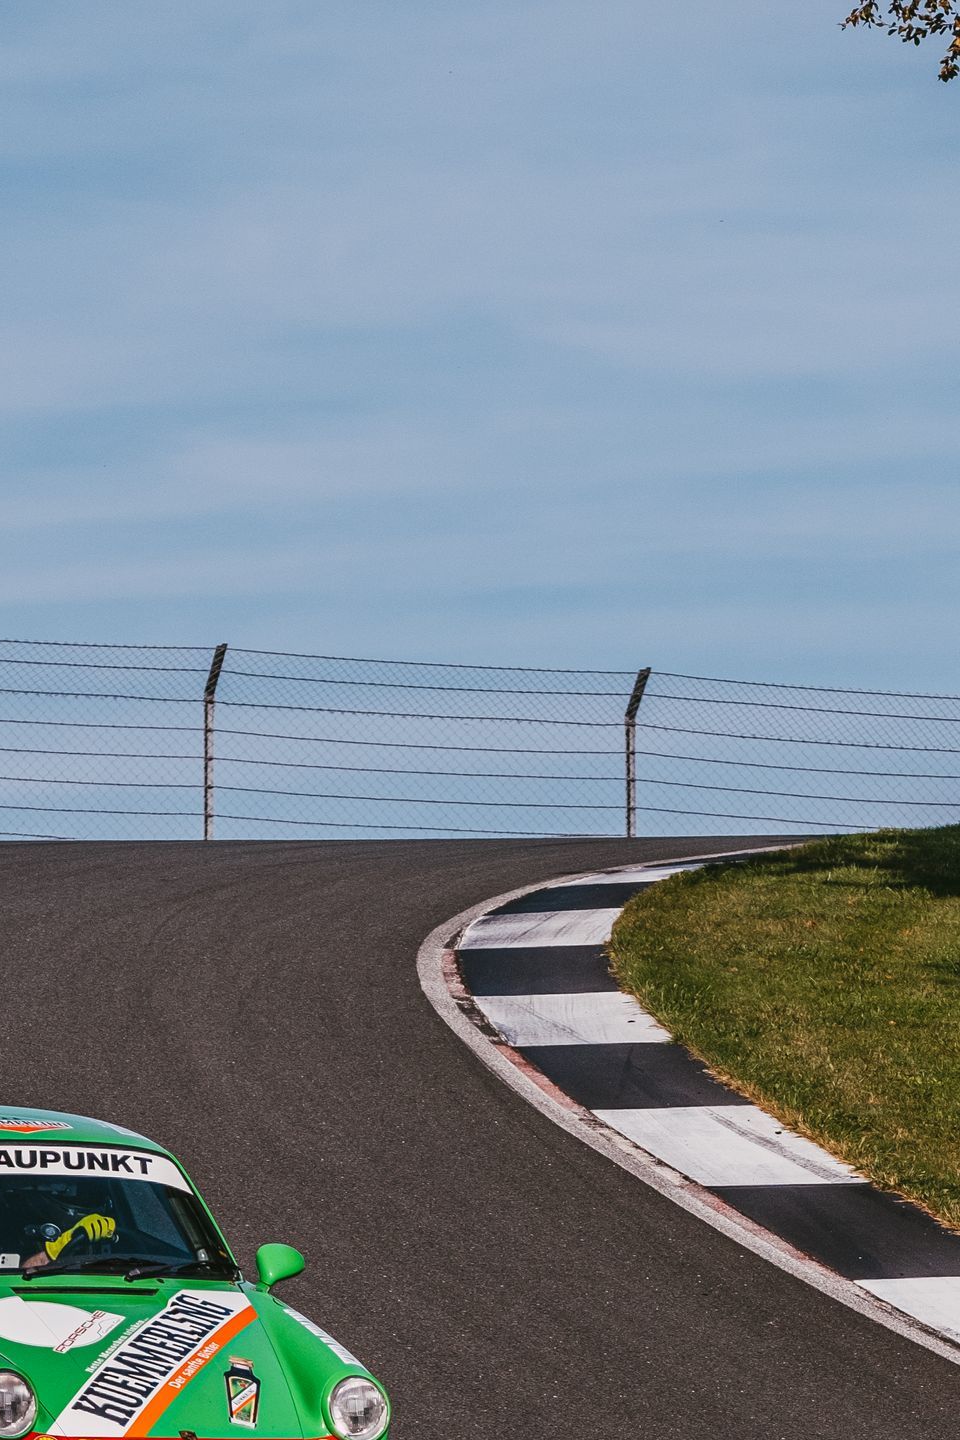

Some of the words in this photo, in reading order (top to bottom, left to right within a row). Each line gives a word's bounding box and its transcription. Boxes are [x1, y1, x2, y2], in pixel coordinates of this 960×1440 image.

[56, 1309, 107, 1353] PORSCHE
[71, 1293, 236, 1428] KUEMMERLING
[168, 1375, 186, 1389] Der
[182, 1357, 206, 1377] sanfte
[197, 1341, 220, 1359] Bitter
